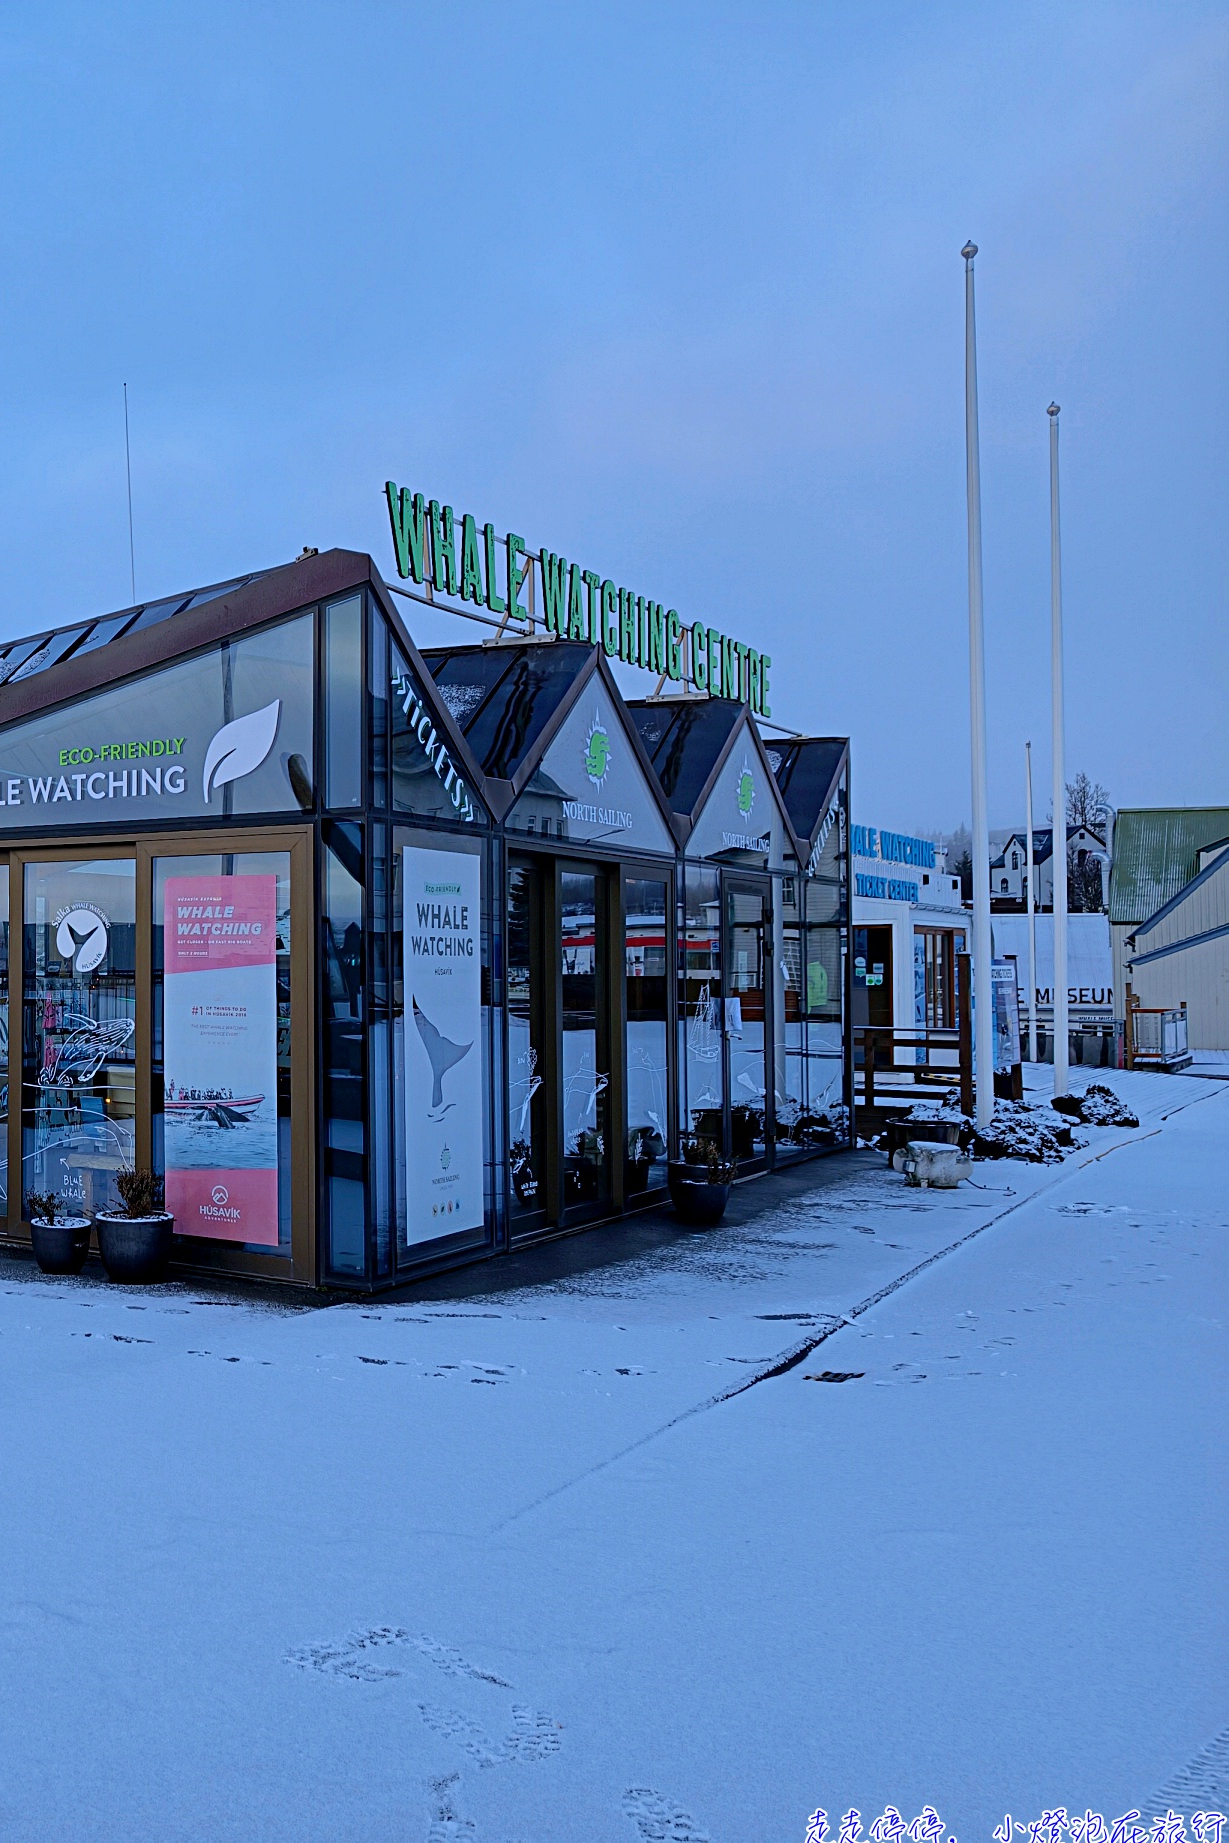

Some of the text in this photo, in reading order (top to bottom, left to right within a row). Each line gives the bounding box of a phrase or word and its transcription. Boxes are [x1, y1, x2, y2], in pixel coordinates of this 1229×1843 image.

[385, 481, 772, 718] WHALE WATCHING CENTRE
[59, 737, 186, 766] ECO-FRIENDLY
[29, 765, 186, 804] WATCHING
[562, 801, 633, 829] NORTH SAILING
[722, 832, 770, 853] NORTH SAILING
[851, 824, 935, 869] ALE WATCHING
[855, 873, 919, 902] TICKET CENTER
[51, 906, 71, 929] Salka
[89, 903, 112, 929] WATCHING
[177, 906, 234, 919] WHALE
[417, 903, 468, 930] WHALE
[177, 923, 262, 935] WATCHING
[411, 936, 473, 956] WATCHING
[1035, 988, 1113, 1004] MSEU
[191, 1006, 203, 1016] #1
[199, 1204, 241, 1219] HÚSAVÍK
